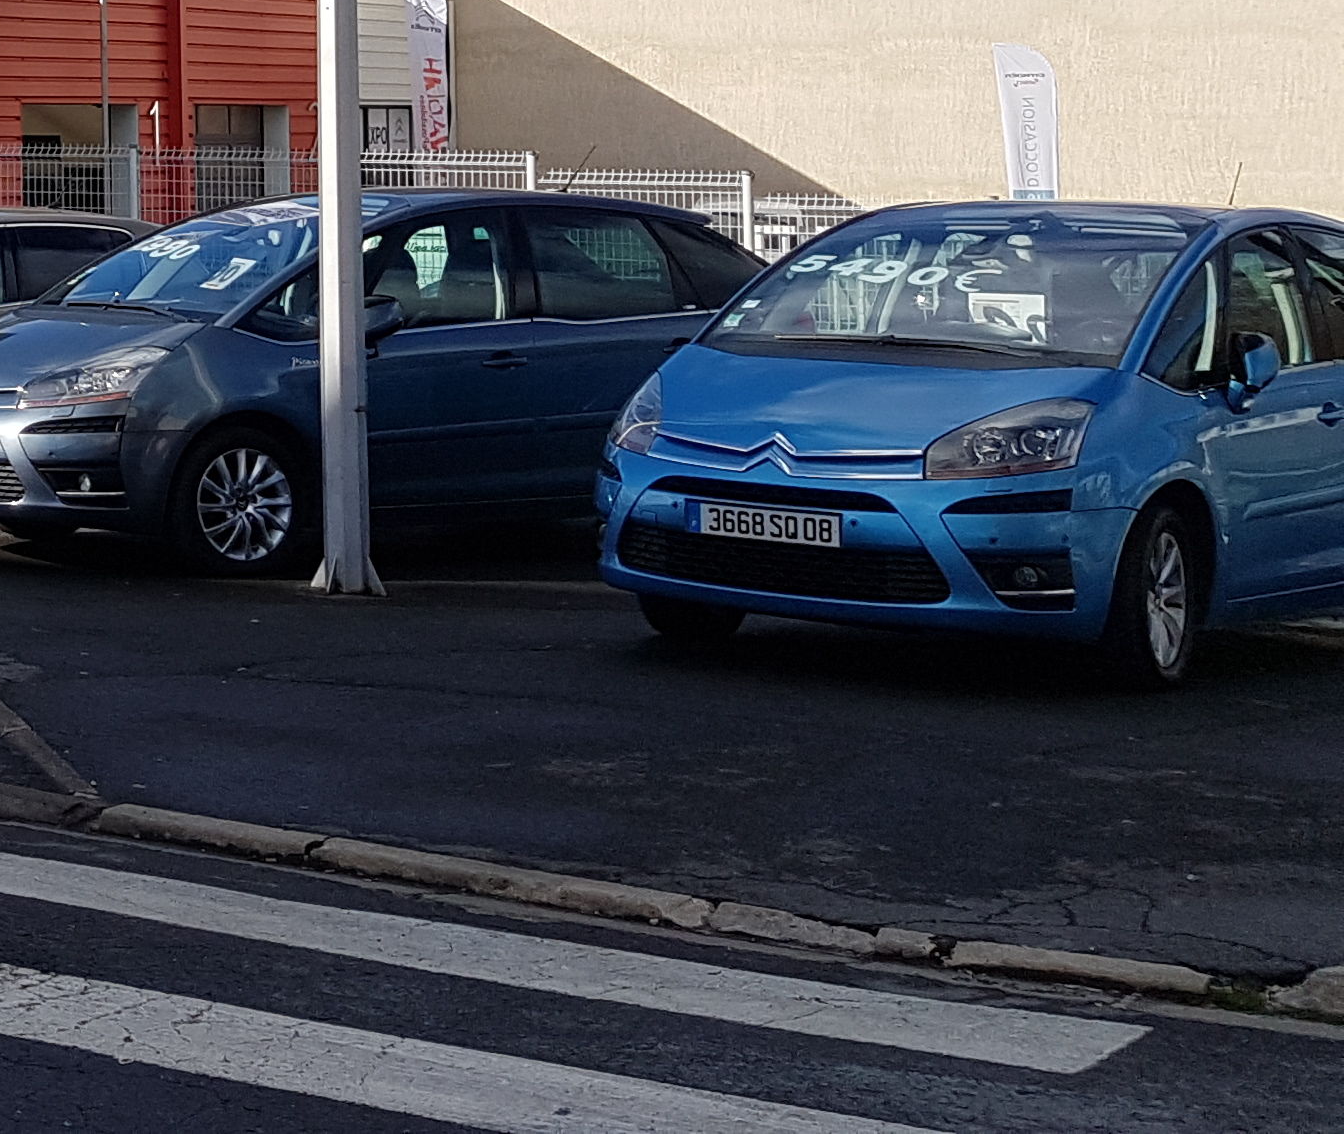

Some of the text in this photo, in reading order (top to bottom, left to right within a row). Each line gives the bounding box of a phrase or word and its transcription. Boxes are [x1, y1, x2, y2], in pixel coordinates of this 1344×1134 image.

[789, 255, 1004, 293] 5490€
[709, 508, 832, 543] 3668 SQ 08
